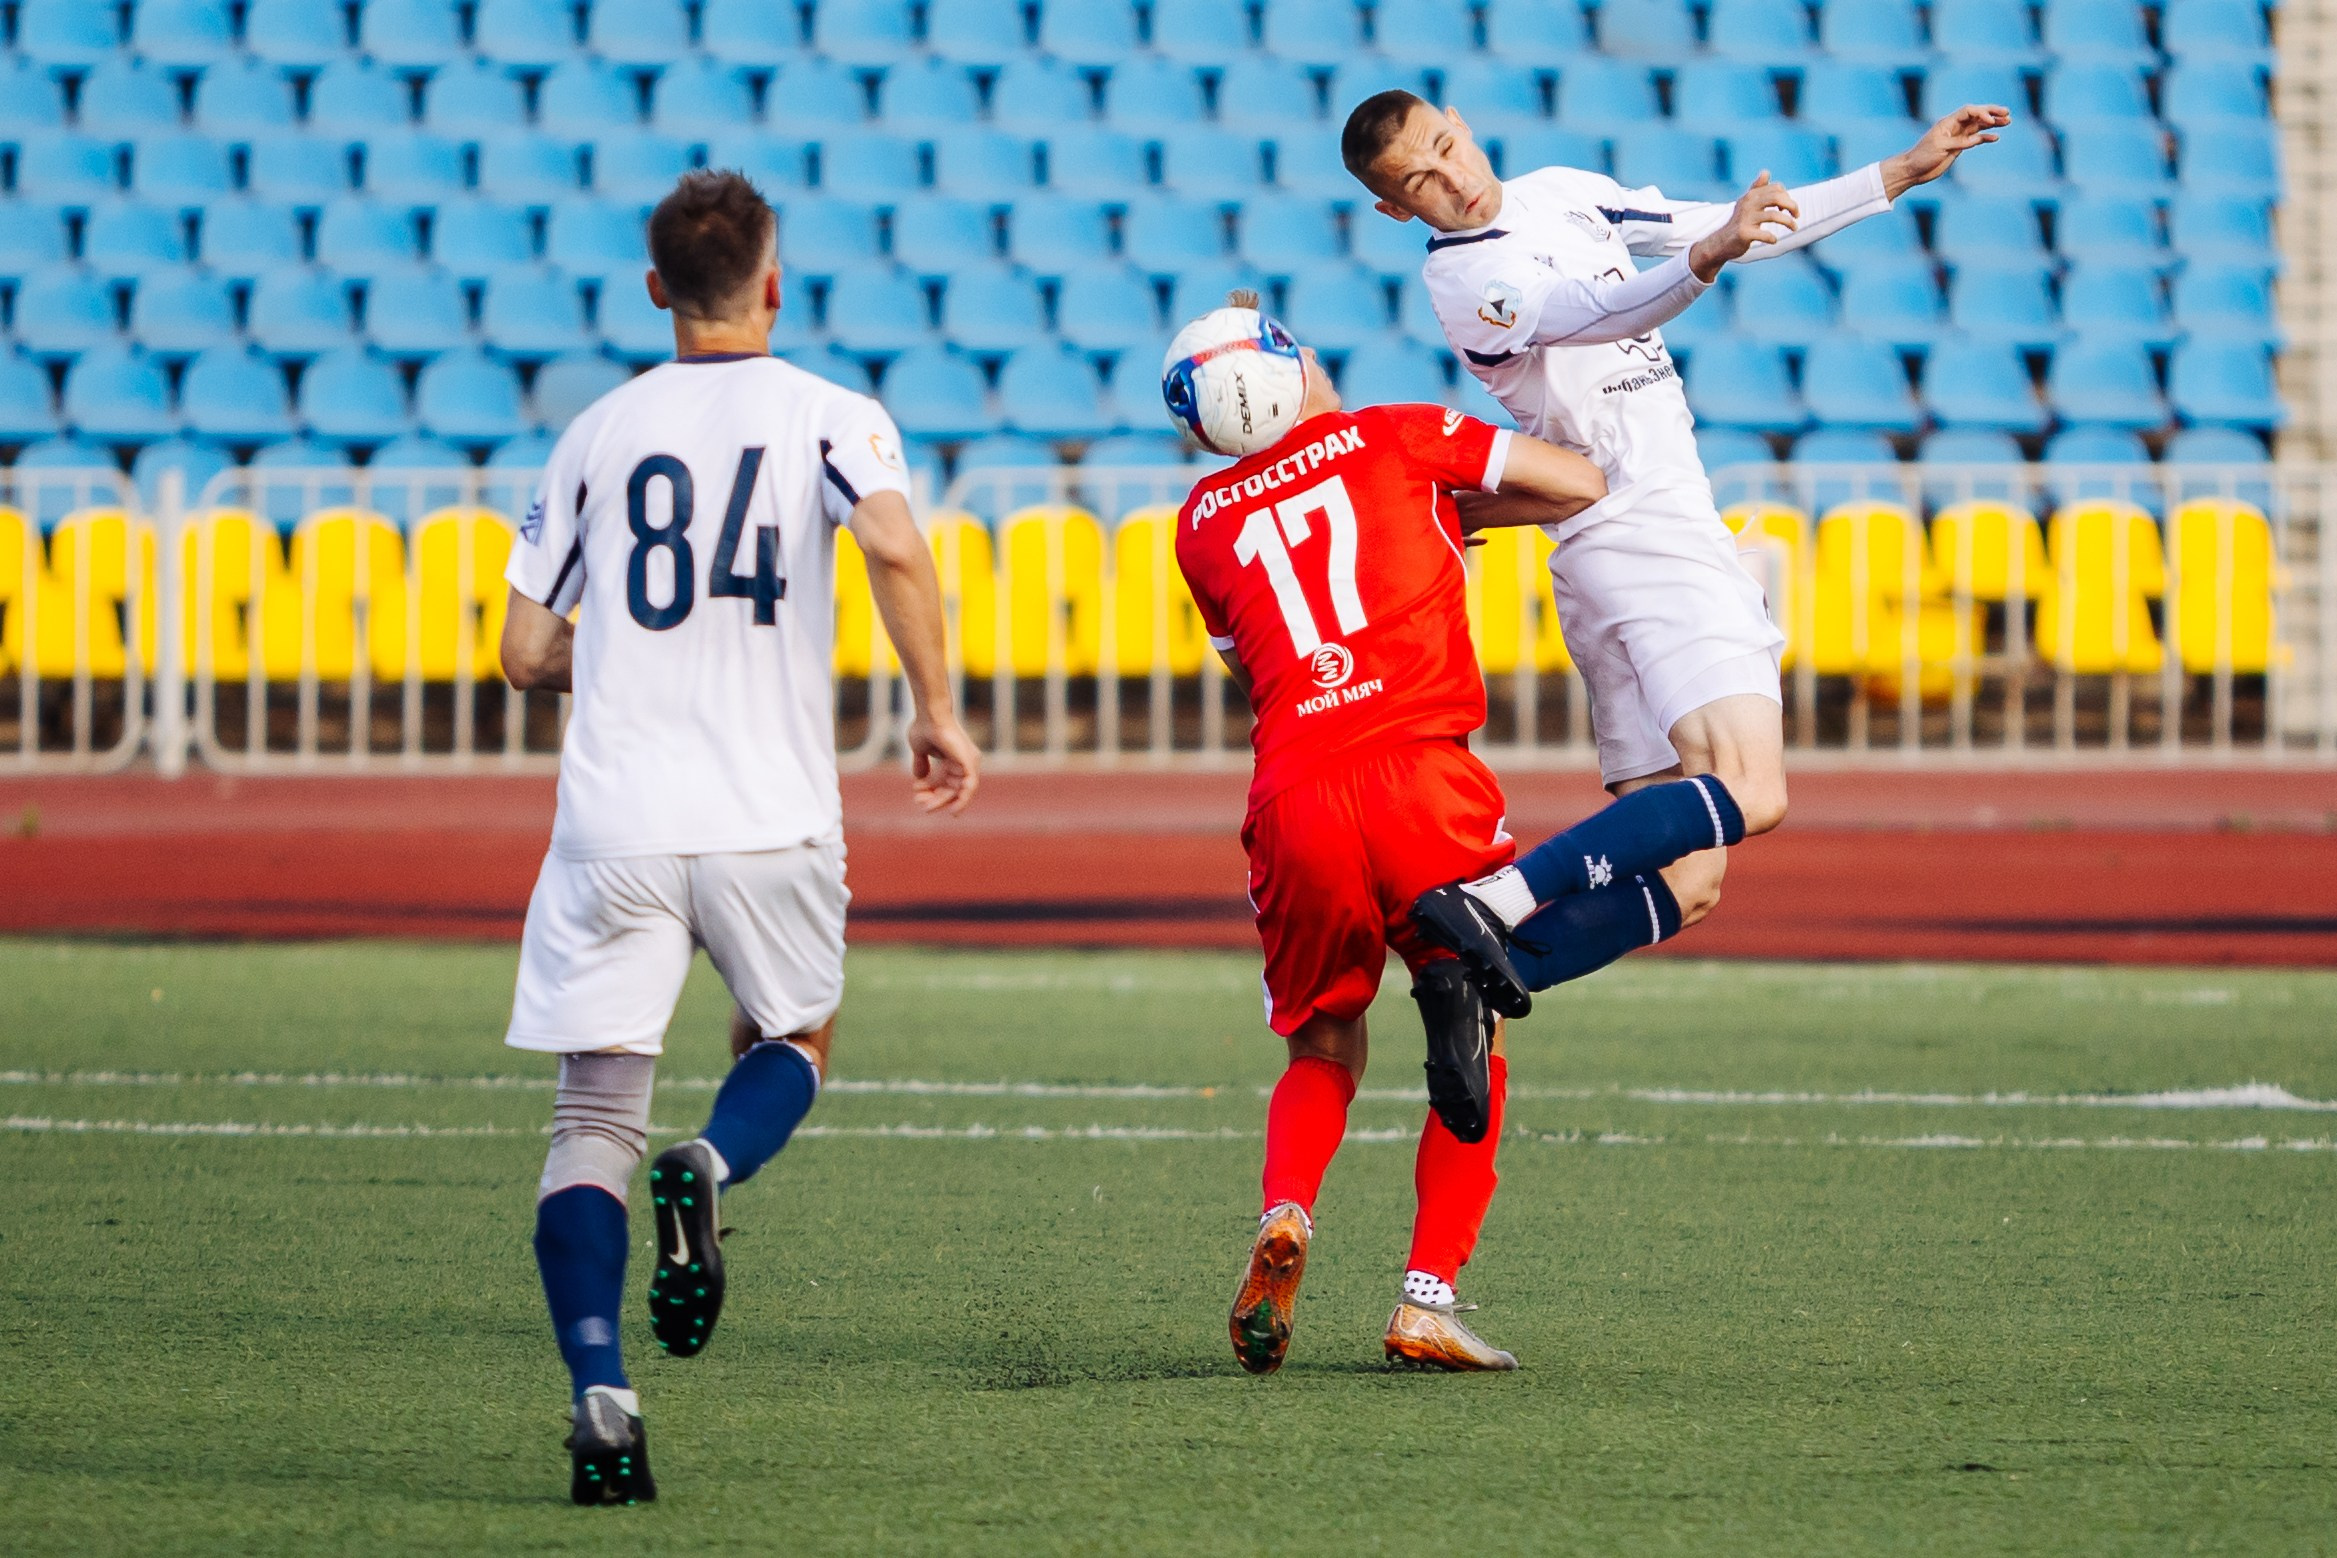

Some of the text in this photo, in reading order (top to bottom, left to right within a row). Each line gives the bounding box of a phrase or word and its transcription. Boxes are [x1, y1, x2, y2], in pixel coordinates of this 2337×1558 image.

[1234, 372, 1252, 434] DEMIX
[1191, 425, 1365, 531] РОСГОССТРАХ
[626, 445, 786, 632] 84
[1233, 475, 1368, 659] 17
[1296, 679, 1384, 717] МОЙ МЯЧ
